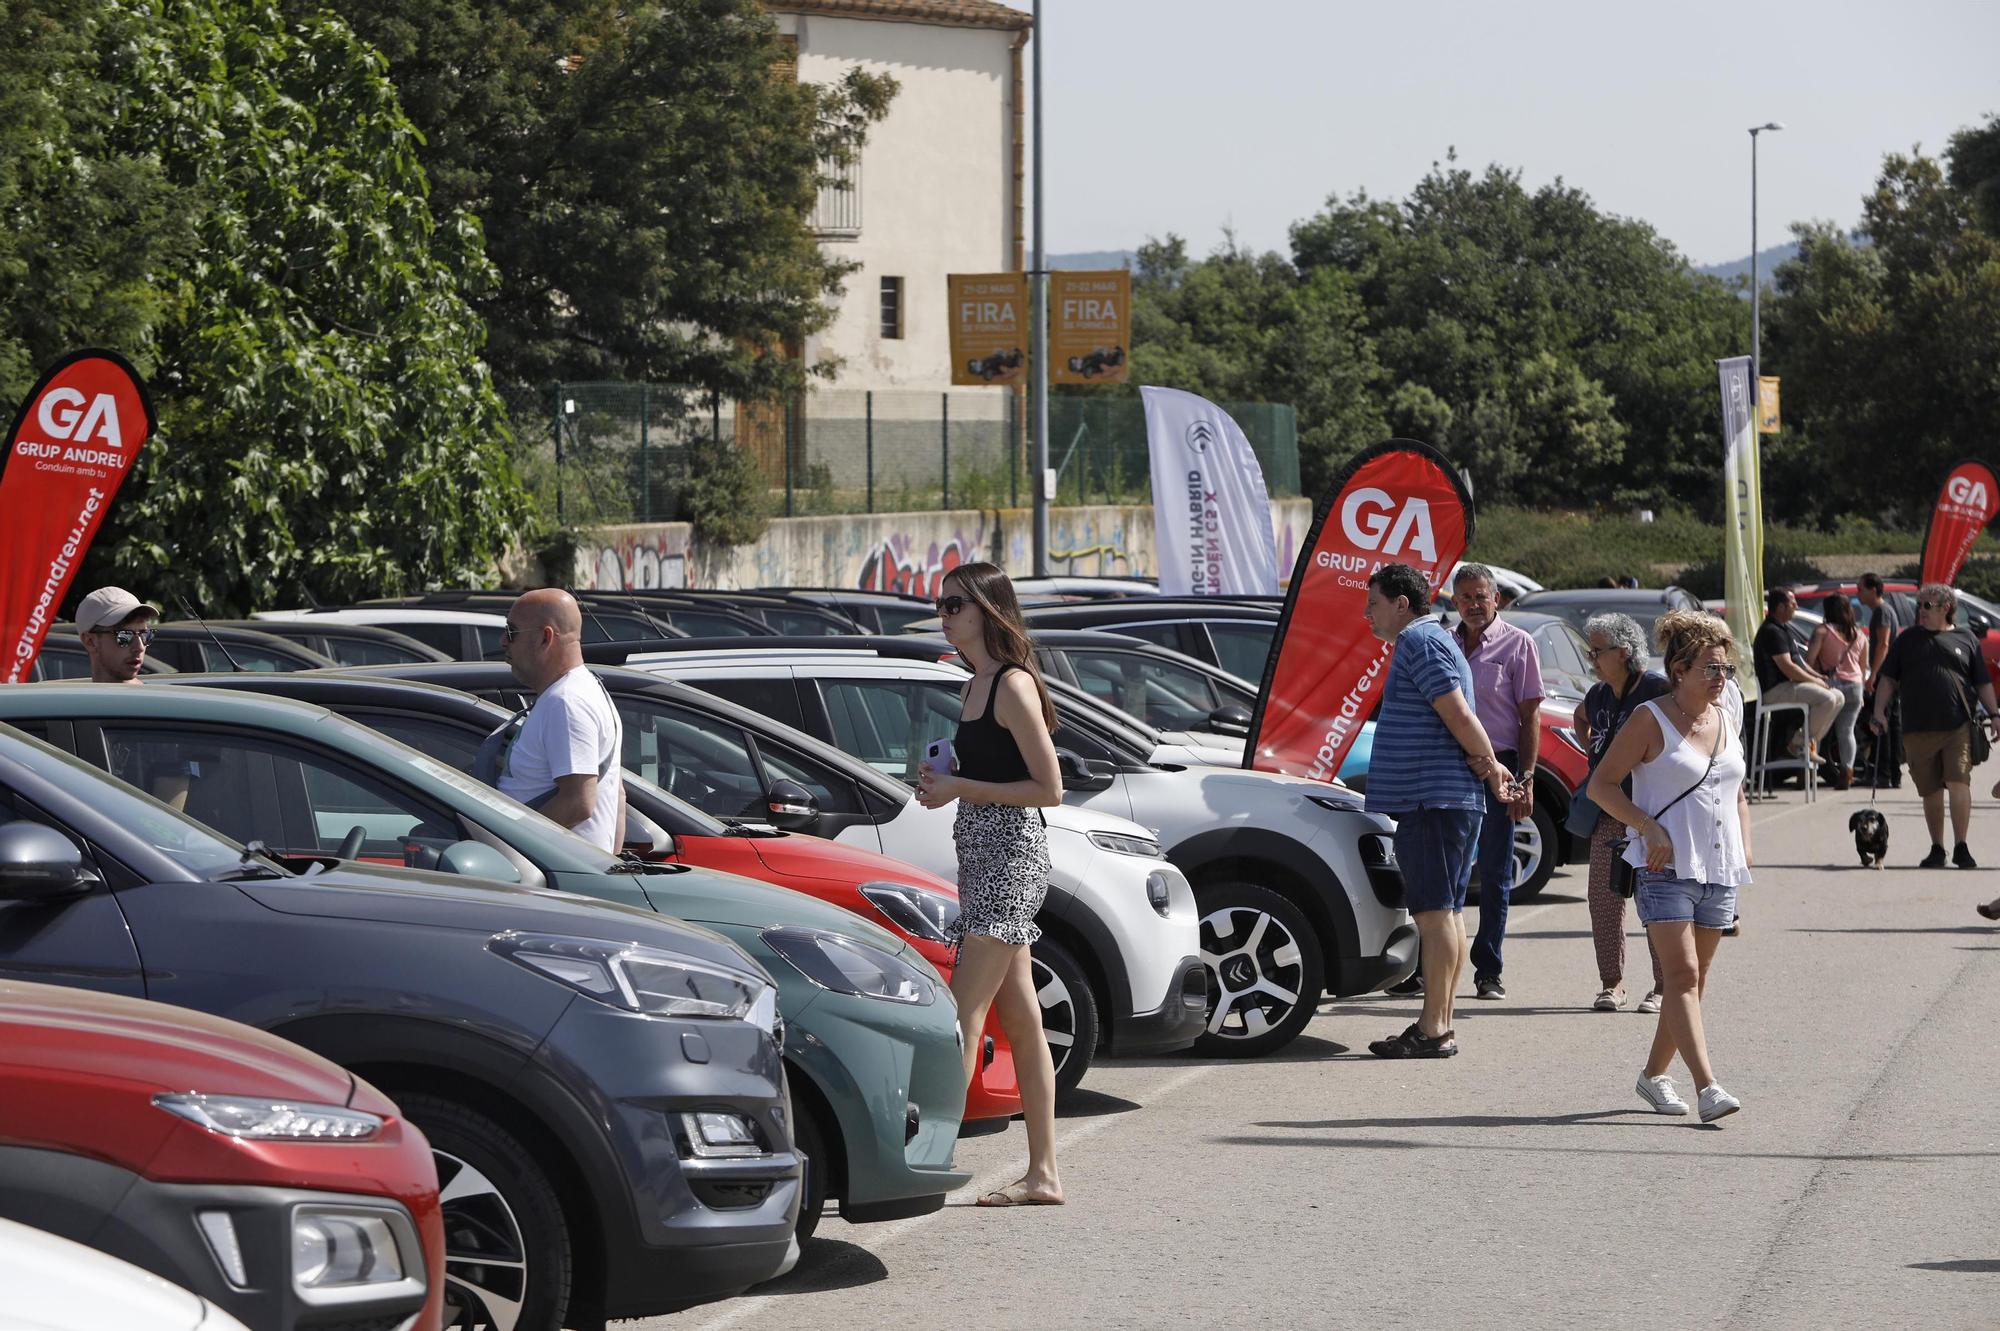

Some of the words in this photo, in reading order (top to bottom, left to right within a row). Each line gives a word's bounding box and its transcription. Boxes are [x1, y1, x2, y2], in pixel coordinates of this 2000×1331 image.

[961, 303, 1016, 322] FIRA
[1063, 300, 1117, 320] FIRA
[38, 386, 122, 448] GA
[16, 441, 61, 458] GRUP
[63, 447, 127, 469] ANDREU
[76, 467, 96, 477] amb
[1948, 476, 1987, 511] GA
[1341, 487, 1438, 563] GA
[1316, 551, 1367, 573] GRUP
[1337, 575, 1370, 590] Condu
[1306, 641, 1394, 780] upandreu.n
